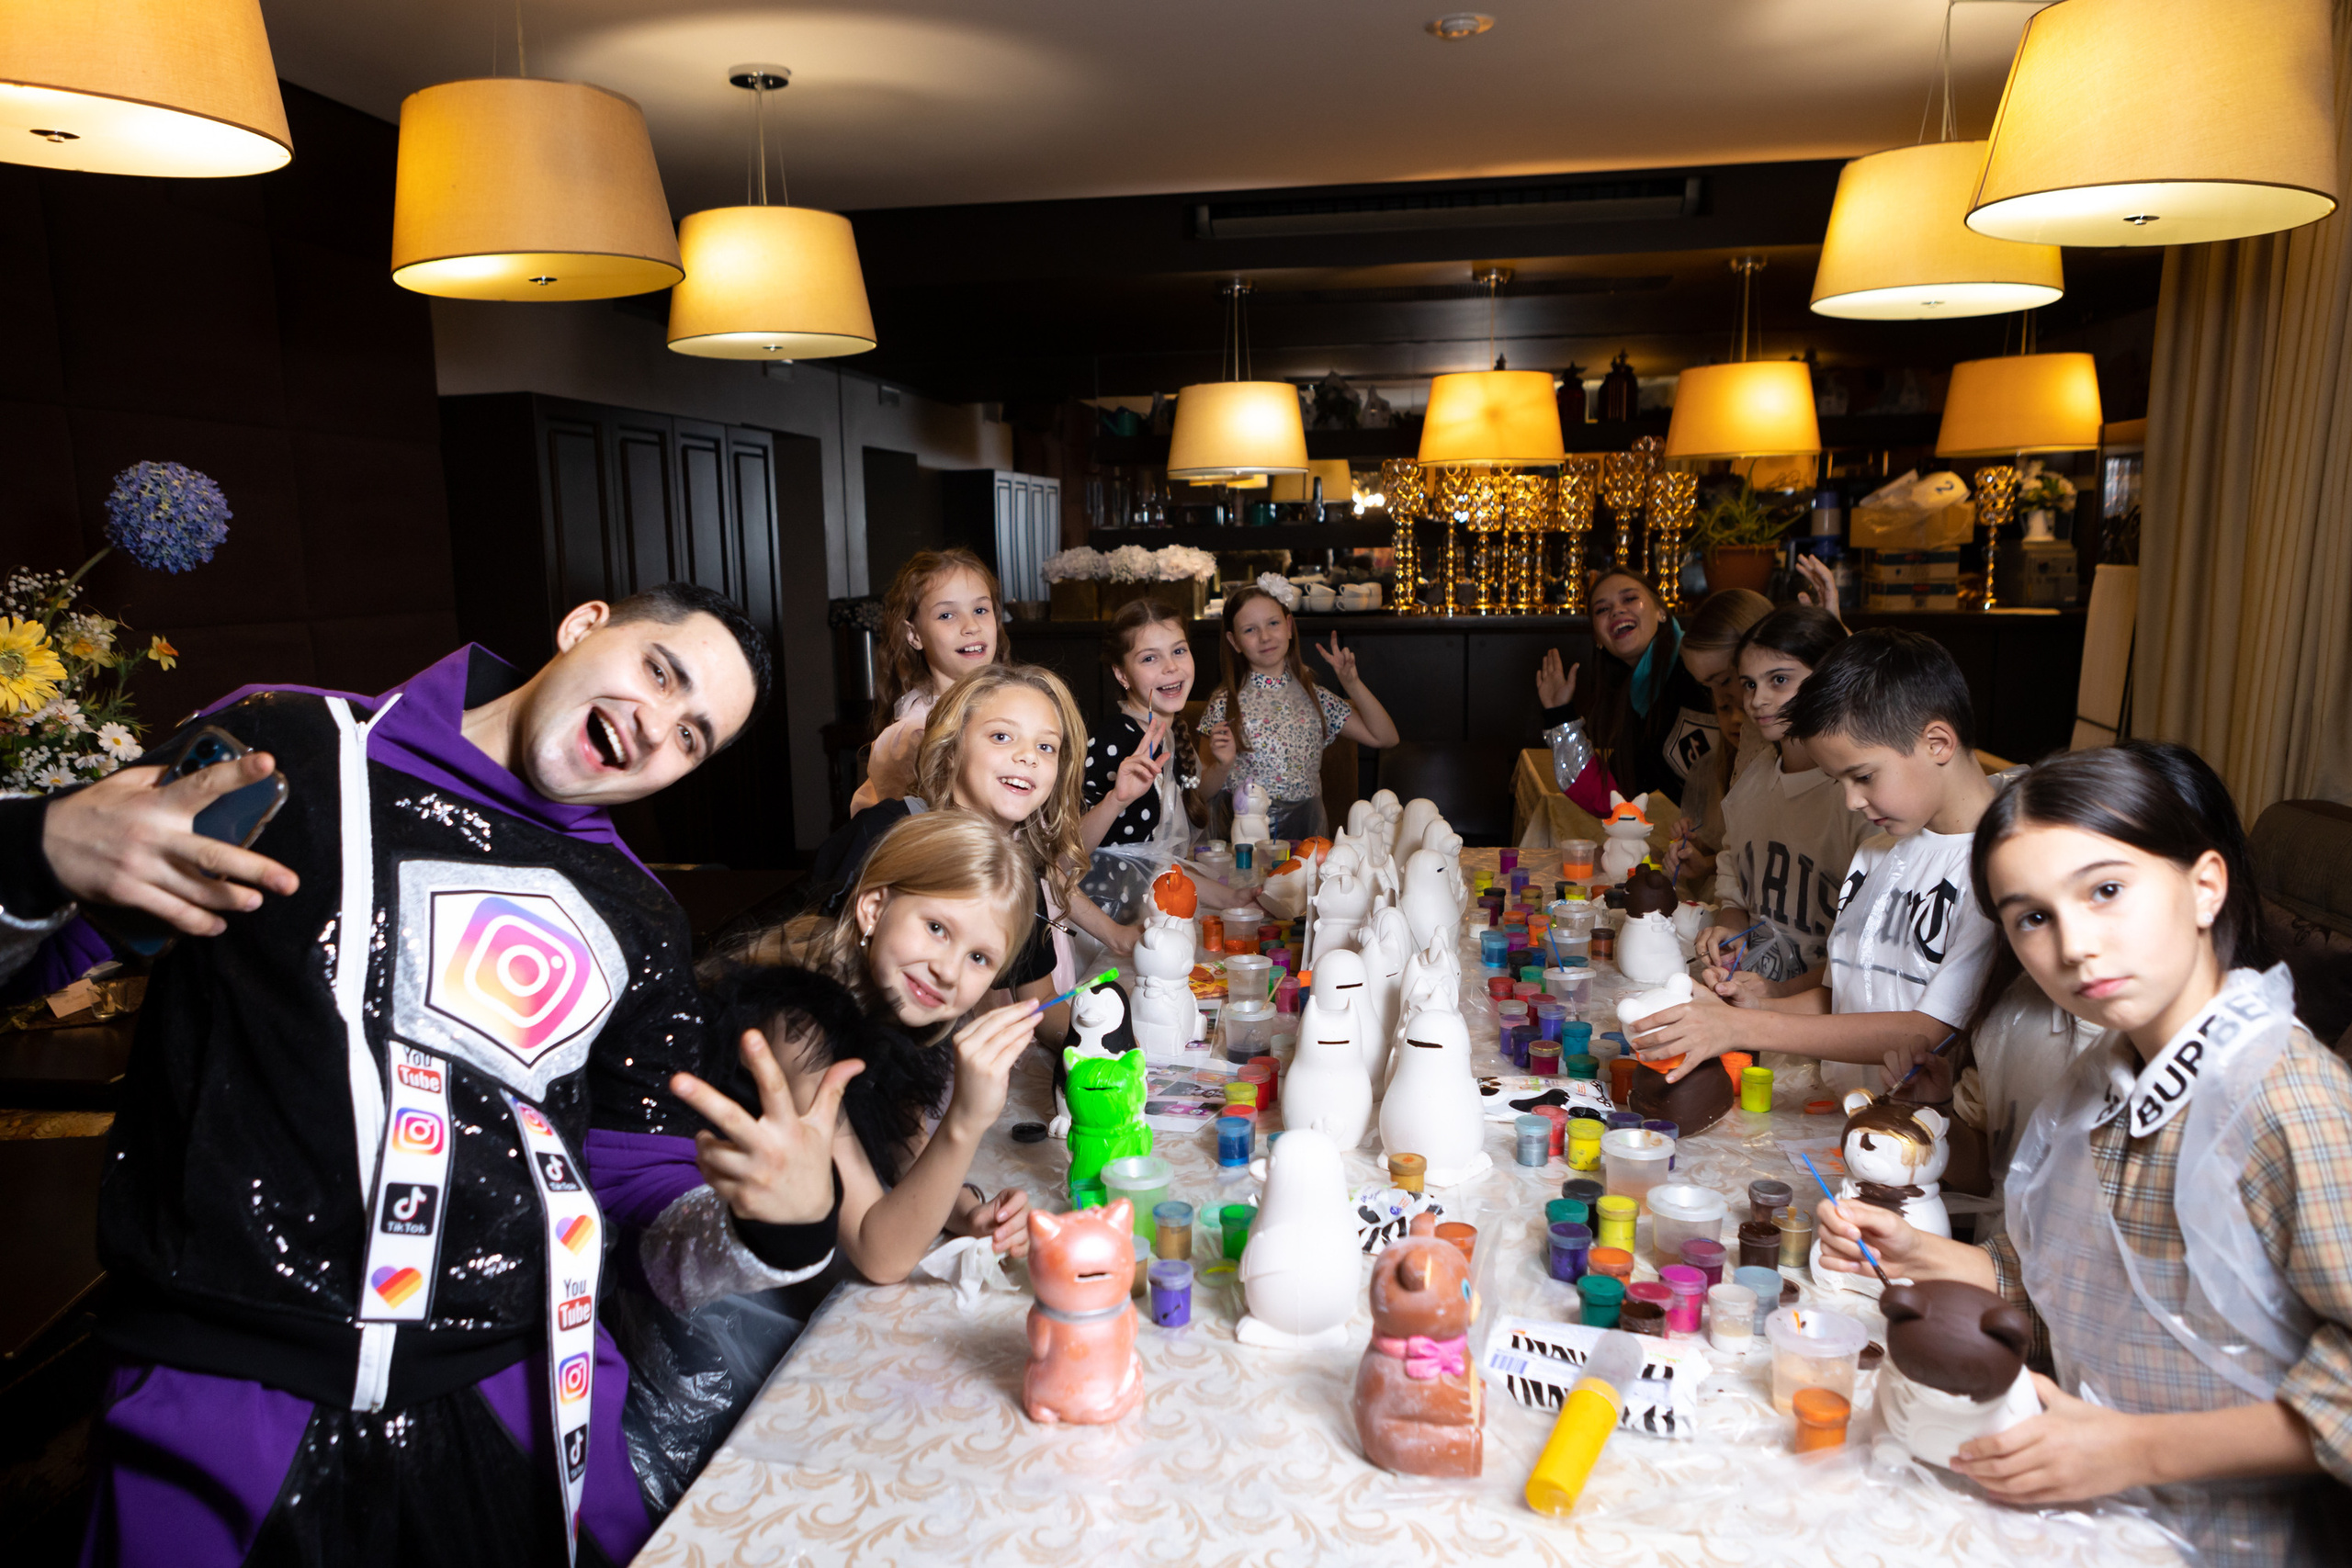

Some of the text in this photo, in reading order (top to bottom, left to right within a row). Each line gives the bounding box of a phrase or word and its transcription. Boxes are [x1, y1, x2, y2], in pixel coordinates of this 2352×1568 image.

[399, 1066, 441, 1092] Tube
[387, 1221, 426, 1234] TikTok
[563, 1278, 587, 1298] You
[560, 1302, 591, 1328] Tube
